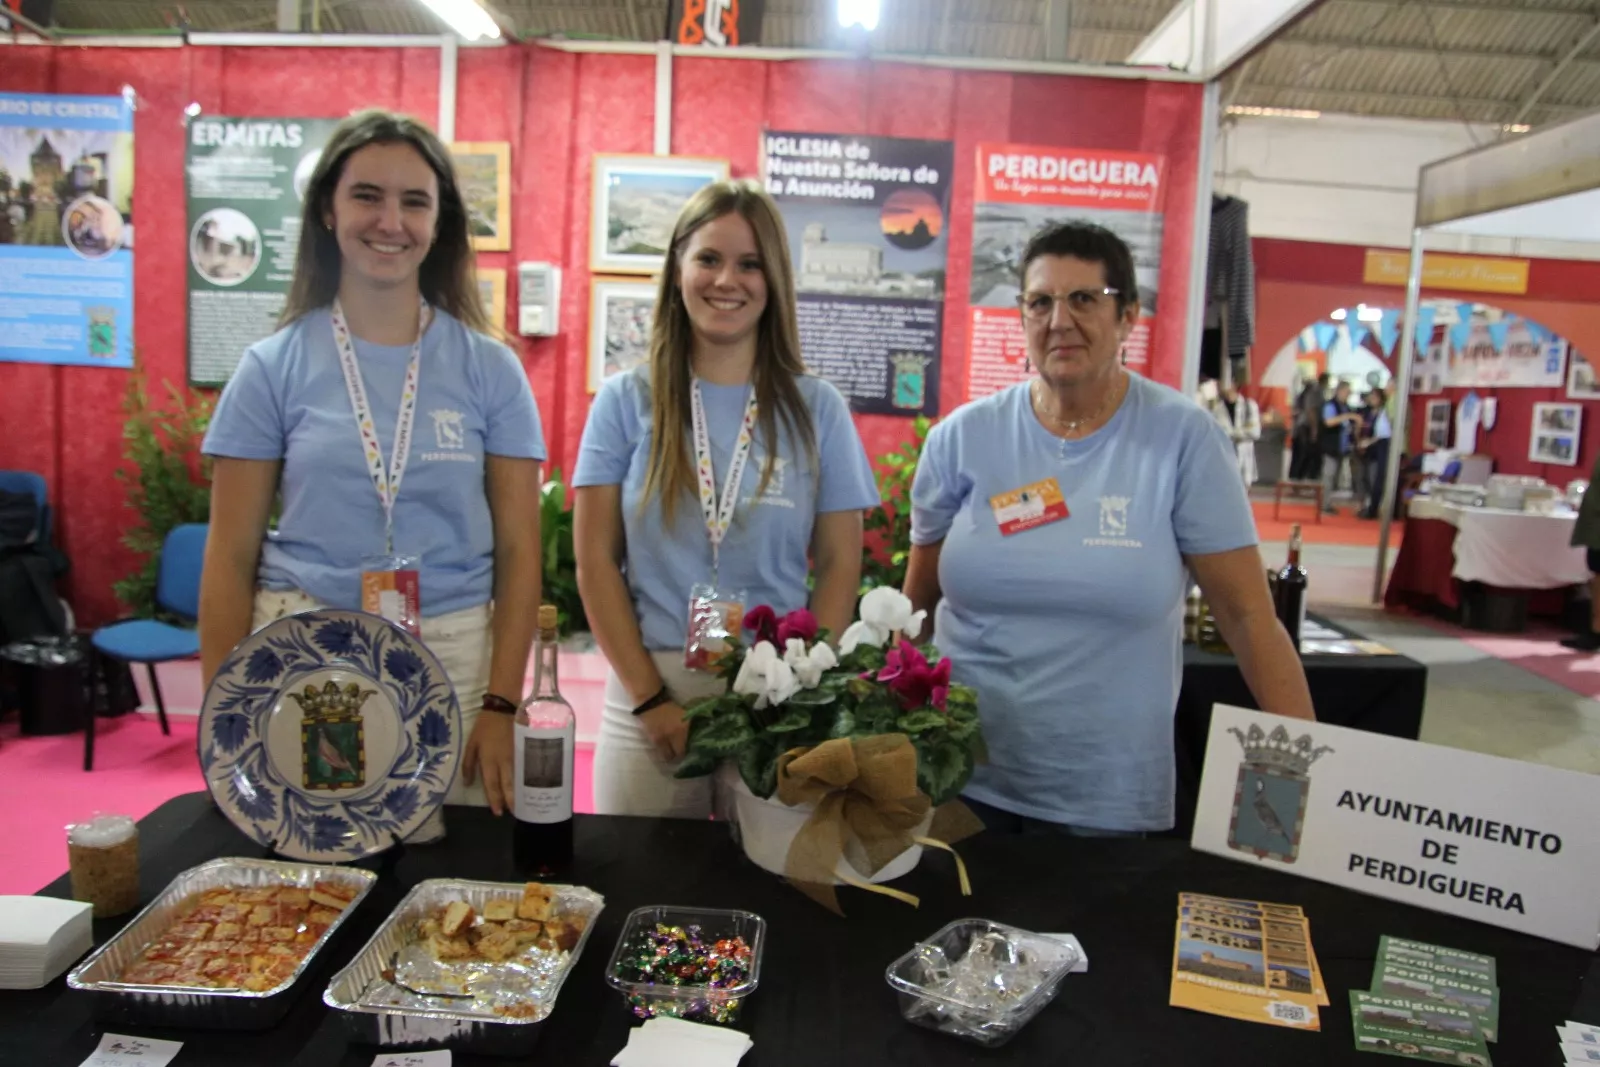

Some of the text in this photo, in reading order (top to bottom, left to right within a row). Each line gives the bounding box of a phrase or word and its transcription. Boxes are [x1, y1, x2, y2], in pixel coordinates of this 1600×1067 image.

[31, 101, 52, 116] DE
[54, 102, 120, 119] CRISTAL
[191, 121, 302, 148] ERMITAS
[766, 137, 870, 160] IGLESIA de
[766, 157, 939, 184] Nuestra Señora de
[989, 154, 1158, 187] PERDIGUERA
[785, 178, 875, 200] Asunción
[1082, 537, 1143, 549] PERDIGUERA
[1336, 790, 1562, 855] AYUNTAMIENTO
[1421, 839, 1459, 865] DE
[1348, 853, 1526, 915] PERDIGUERA
[1384, 966, 1492, 995] Perdiguera
[1358, 993, 1470, 1017] Perdiguera
